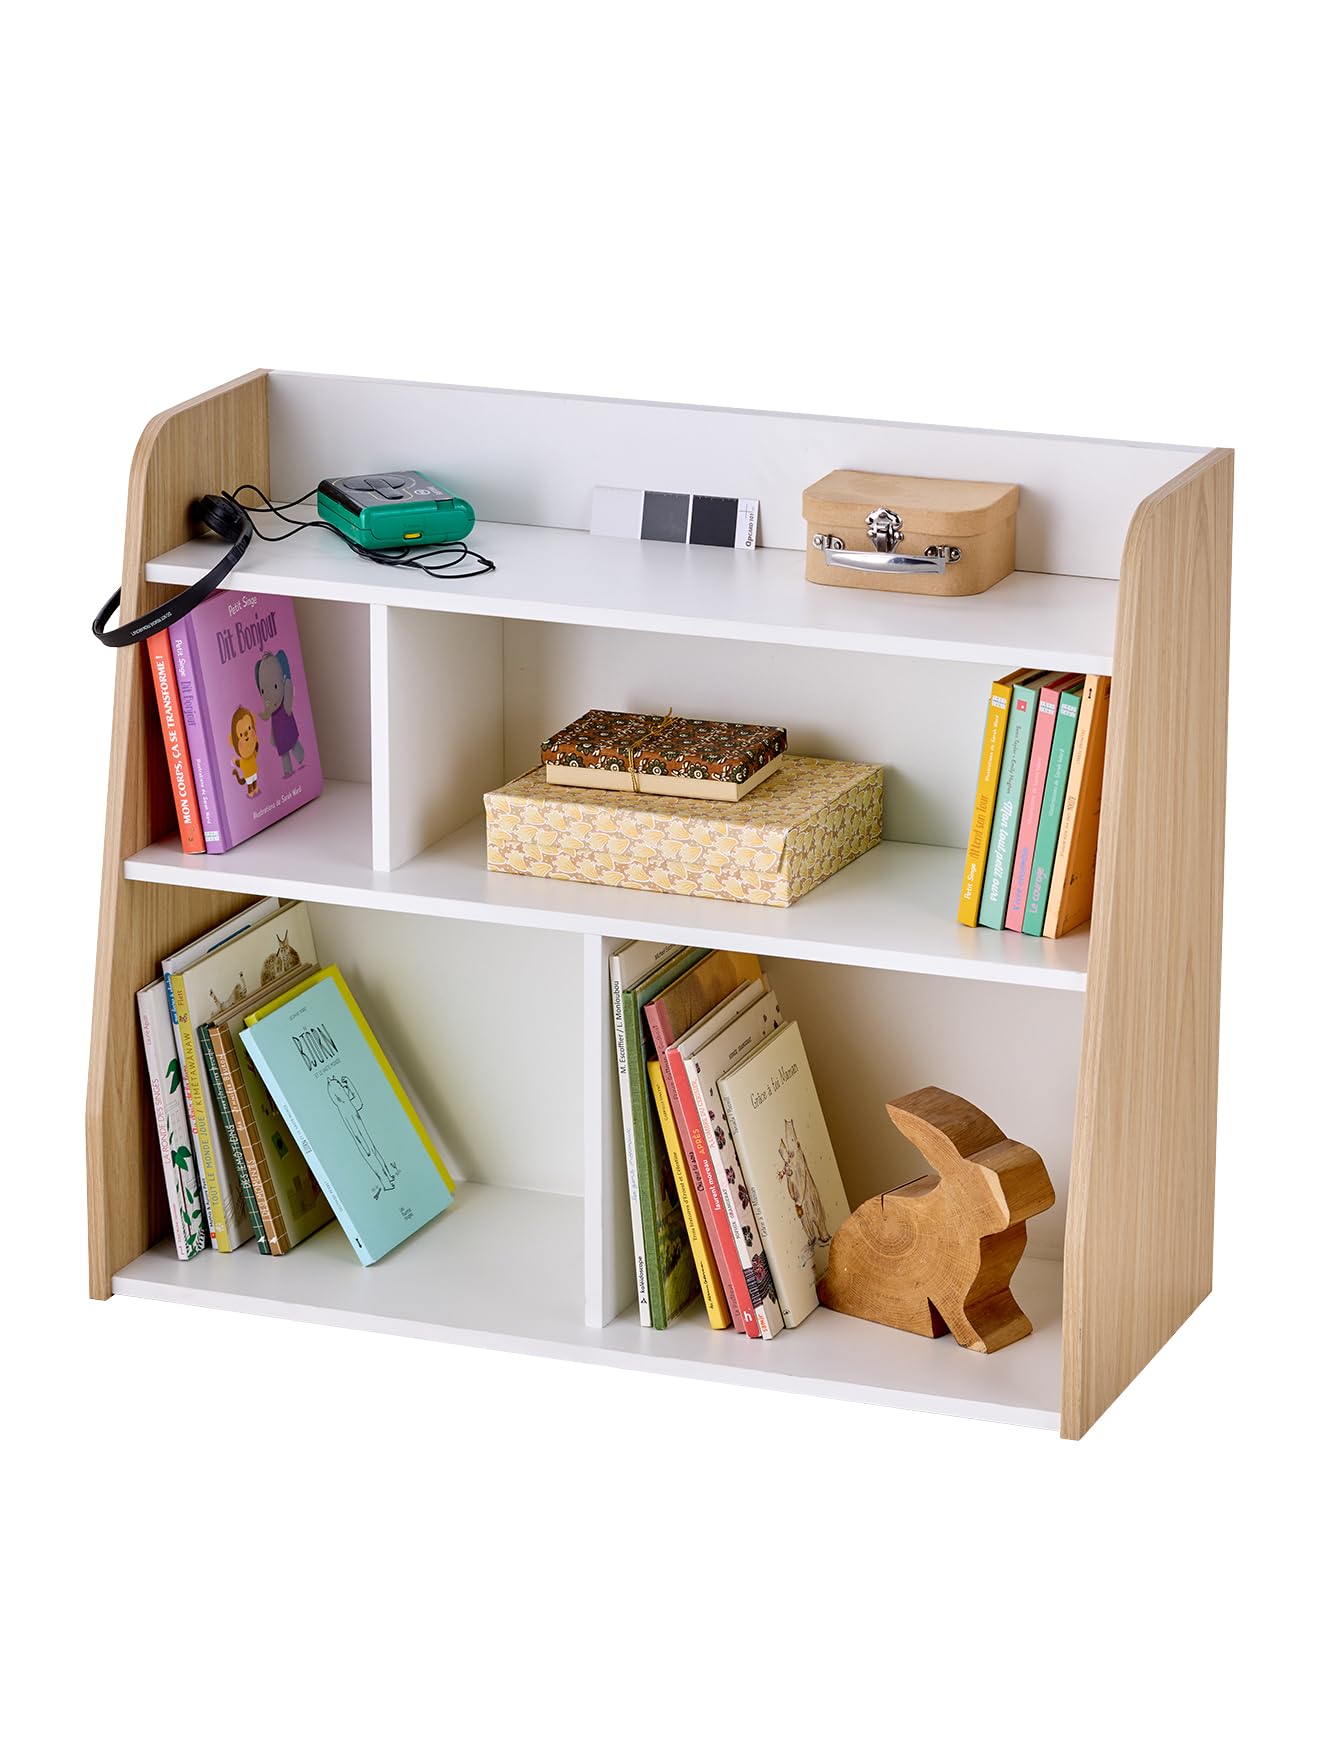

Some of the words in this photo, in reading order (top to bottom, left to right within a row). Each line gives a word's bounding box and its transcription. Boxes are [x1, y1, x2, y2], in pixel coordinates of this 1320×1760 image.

[228, 600, 241, 616] Petit
[242, 596, 258, 608] Singe
[216, 630, 236, 664] Dit
[236, 610, 278, 653] Bonjour
[175, 639, 183, 656] Petit
[178, 658, 186, 676] Singe
[157, 662, 174, 727] TRANSFORME
[180, 680, 191, 693] Dit
[180, 694, 198, 726] Bonjour
[168, 730, 177, 742] SE
[171, 744, 181, 758] ÇA
[174, 760, 186, 797] CORPS,
[181, 799, 191, 823] MON
[1001, 801, 1012, 827] Mon
[997, 829, 1008, 850] tout
[967, 863, 976, 881] Singe
[993, 849, 1005, 878] petit
[964, 883, 972, 899] Petit
[990, 879, 999, 901] ours
[1032, 867, 1046, 901] courage
[1029, 903, 1038, 912] Le
[175, 989, 184, 1006] Flett
[291, 1024, 338, 1071] BJÖRN
[620, 1065, 626, 1073] M.
[151, 1079, 163, 1105] SINGES
[751, 1089, 768, 1109] Grâce
[768, 1087, 773, 1096] à
[780, 1063, 800, 1084] Maman
[155, 1106, 165, 1122] DES
[197, 1117, 207, 1136] JOUE
[156, 1124, 171, 1152] RONDE
[692, 1128, 705, 1154] APRÈS
[163, 1154, 171, 1164] LA
[201, 1140, 212, 1168] MONDE
[207, 1173, 215, 1181] LE
[239, 1173, 251, 1189] DES
[246, 1158, 264, 1199] MOMENTS
[703, 1159, 713, 1185] moreau
[209, 1186, 219, 1205] TOUT
[696, 1181, 704, 1192] Où
[709, 1186, 720, 1210] laurent
[257, 1200, 268, 1217] DES
[732, 1221, 740, 1239] SOPHIE
